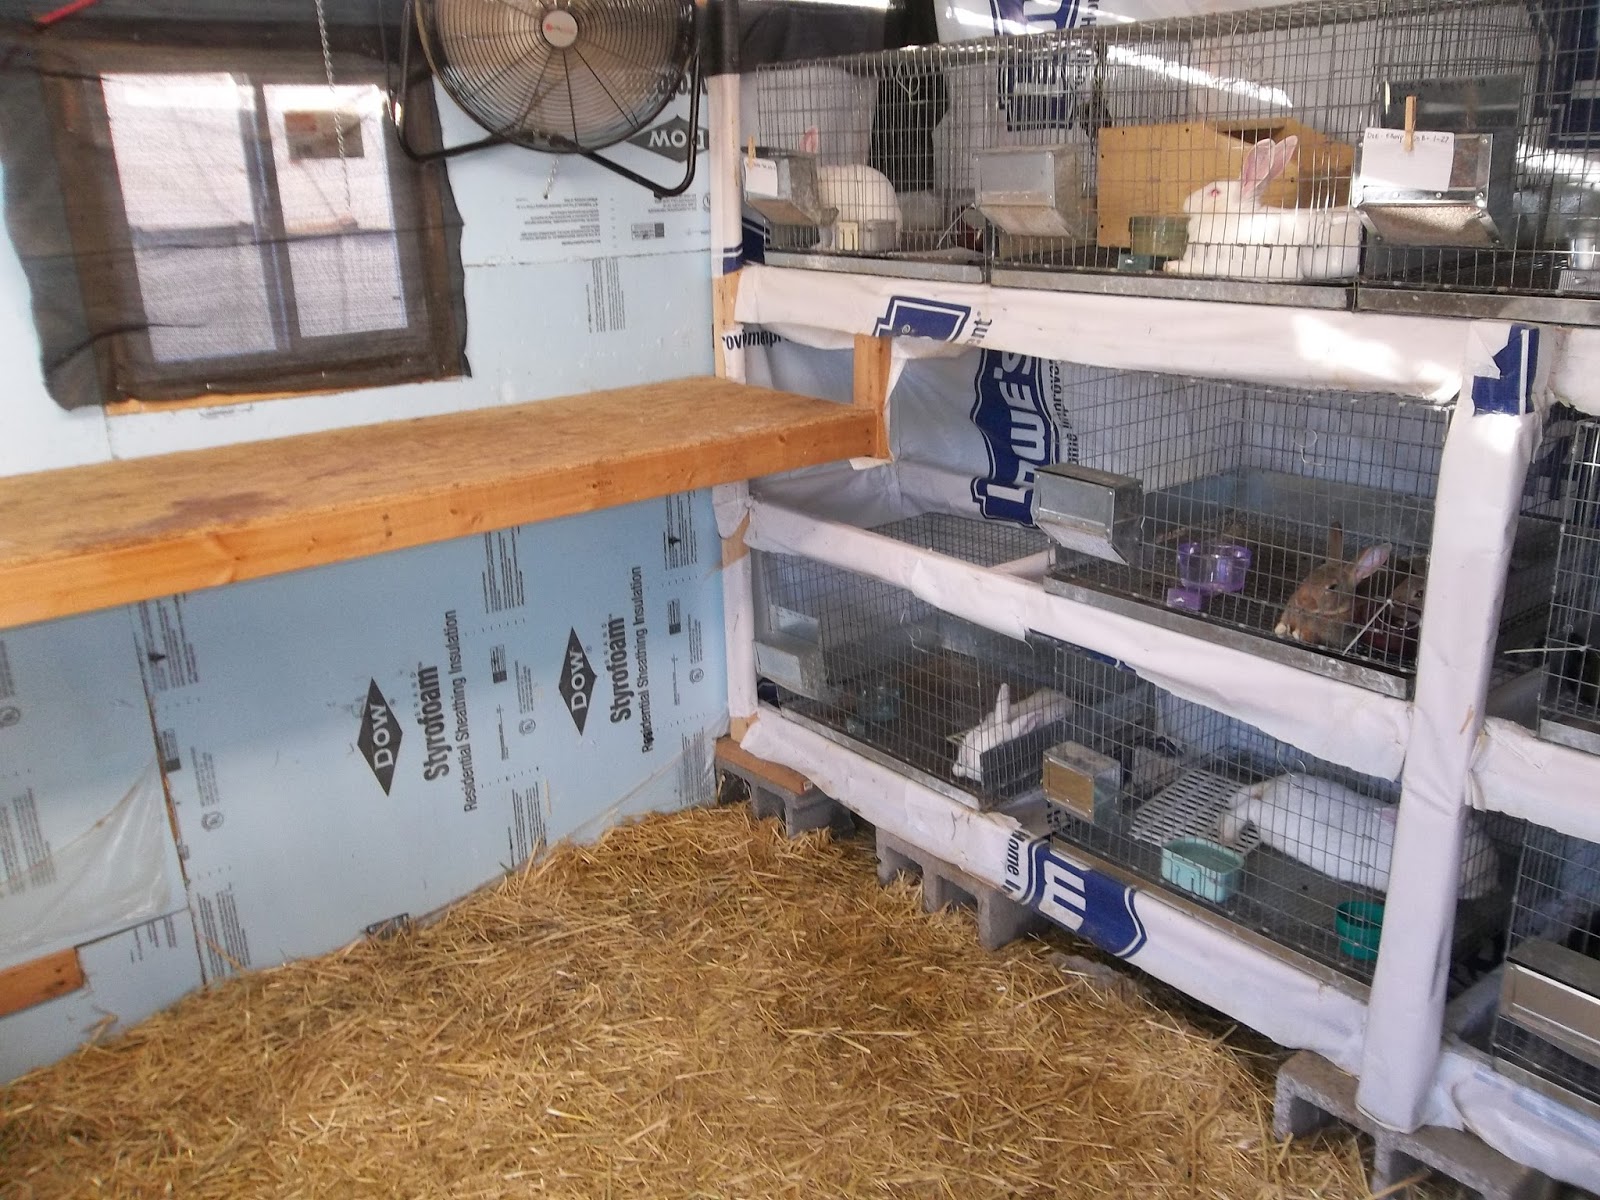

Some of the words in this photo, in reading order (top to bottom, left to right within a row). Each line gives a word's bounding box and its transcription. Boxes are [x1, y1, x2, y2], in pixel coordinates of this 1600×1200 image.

[631, 565, 645, 626] Insulation
[443, 609, 463, 675] Insulation
[633, 627, 649, 688] Sheathing
[450, 676, 470, 743] Sheathing
[569, 649, 588, 712] DOW
[370, 702, 394, 770] DOW
[637, 692, 655, 754] Residential
[457, 743, 478, 813] Residential
